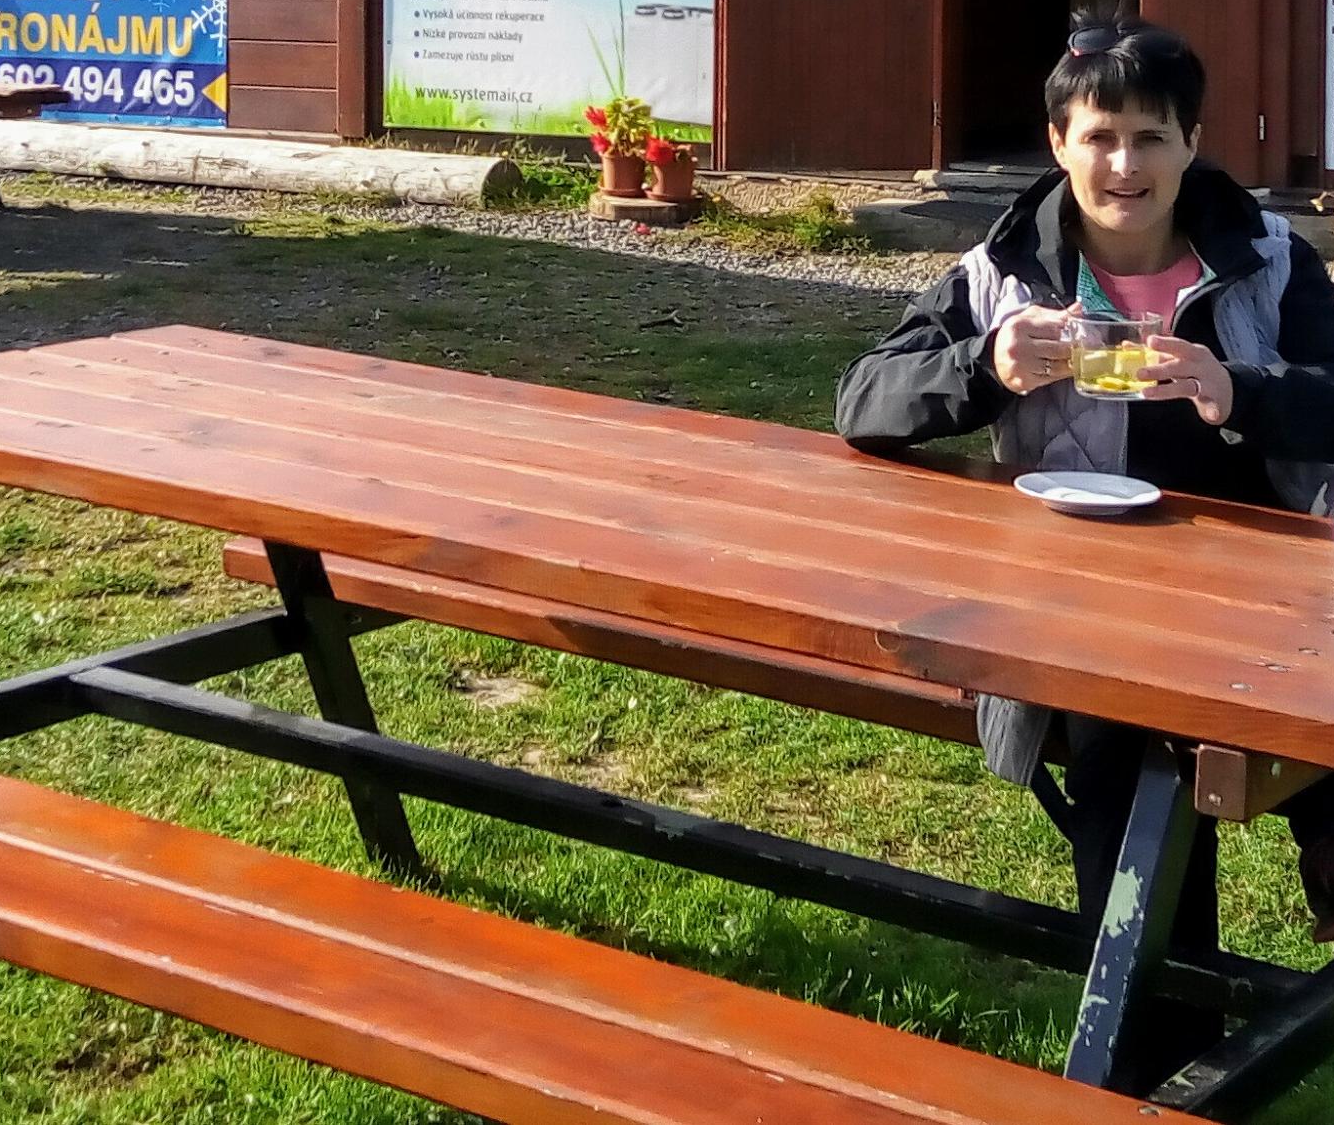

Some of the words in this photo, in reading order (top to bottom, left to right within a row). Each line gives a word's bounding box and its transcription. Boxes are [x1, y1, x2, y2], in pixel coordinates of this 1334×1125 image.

[422, 9, 454, 21] Vysoká
[495, 11, 545, 22] rekuperace
[422, 49, 464, 62] Zamezuje
[62, 66, 124, 104] 494
[132, 69, 195, 107] 465
[415, 88, 533, 105] www.systemair.cz
